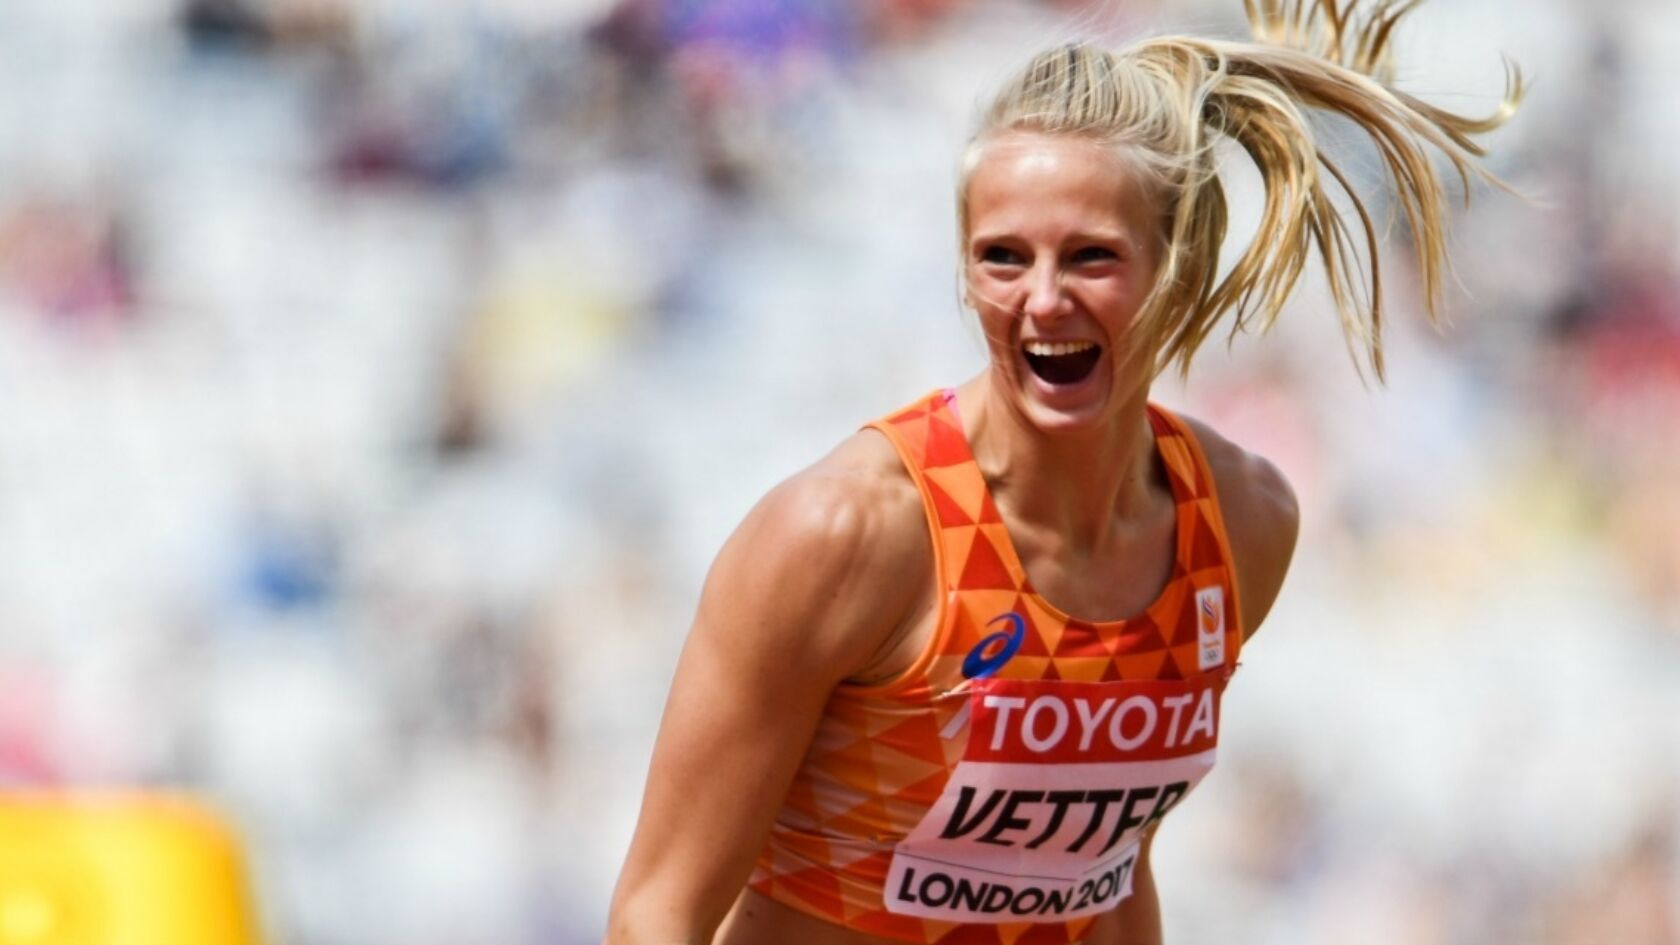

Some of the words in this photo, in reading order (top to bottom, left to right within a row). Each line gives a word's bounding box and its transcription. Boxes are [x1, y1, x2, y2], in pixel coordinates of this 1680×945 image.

[984, 687, 1215, 752] TOYOTA
[897, 868, 1074, 916] LONDON
[1070, 855, 1134, 911] 2017
